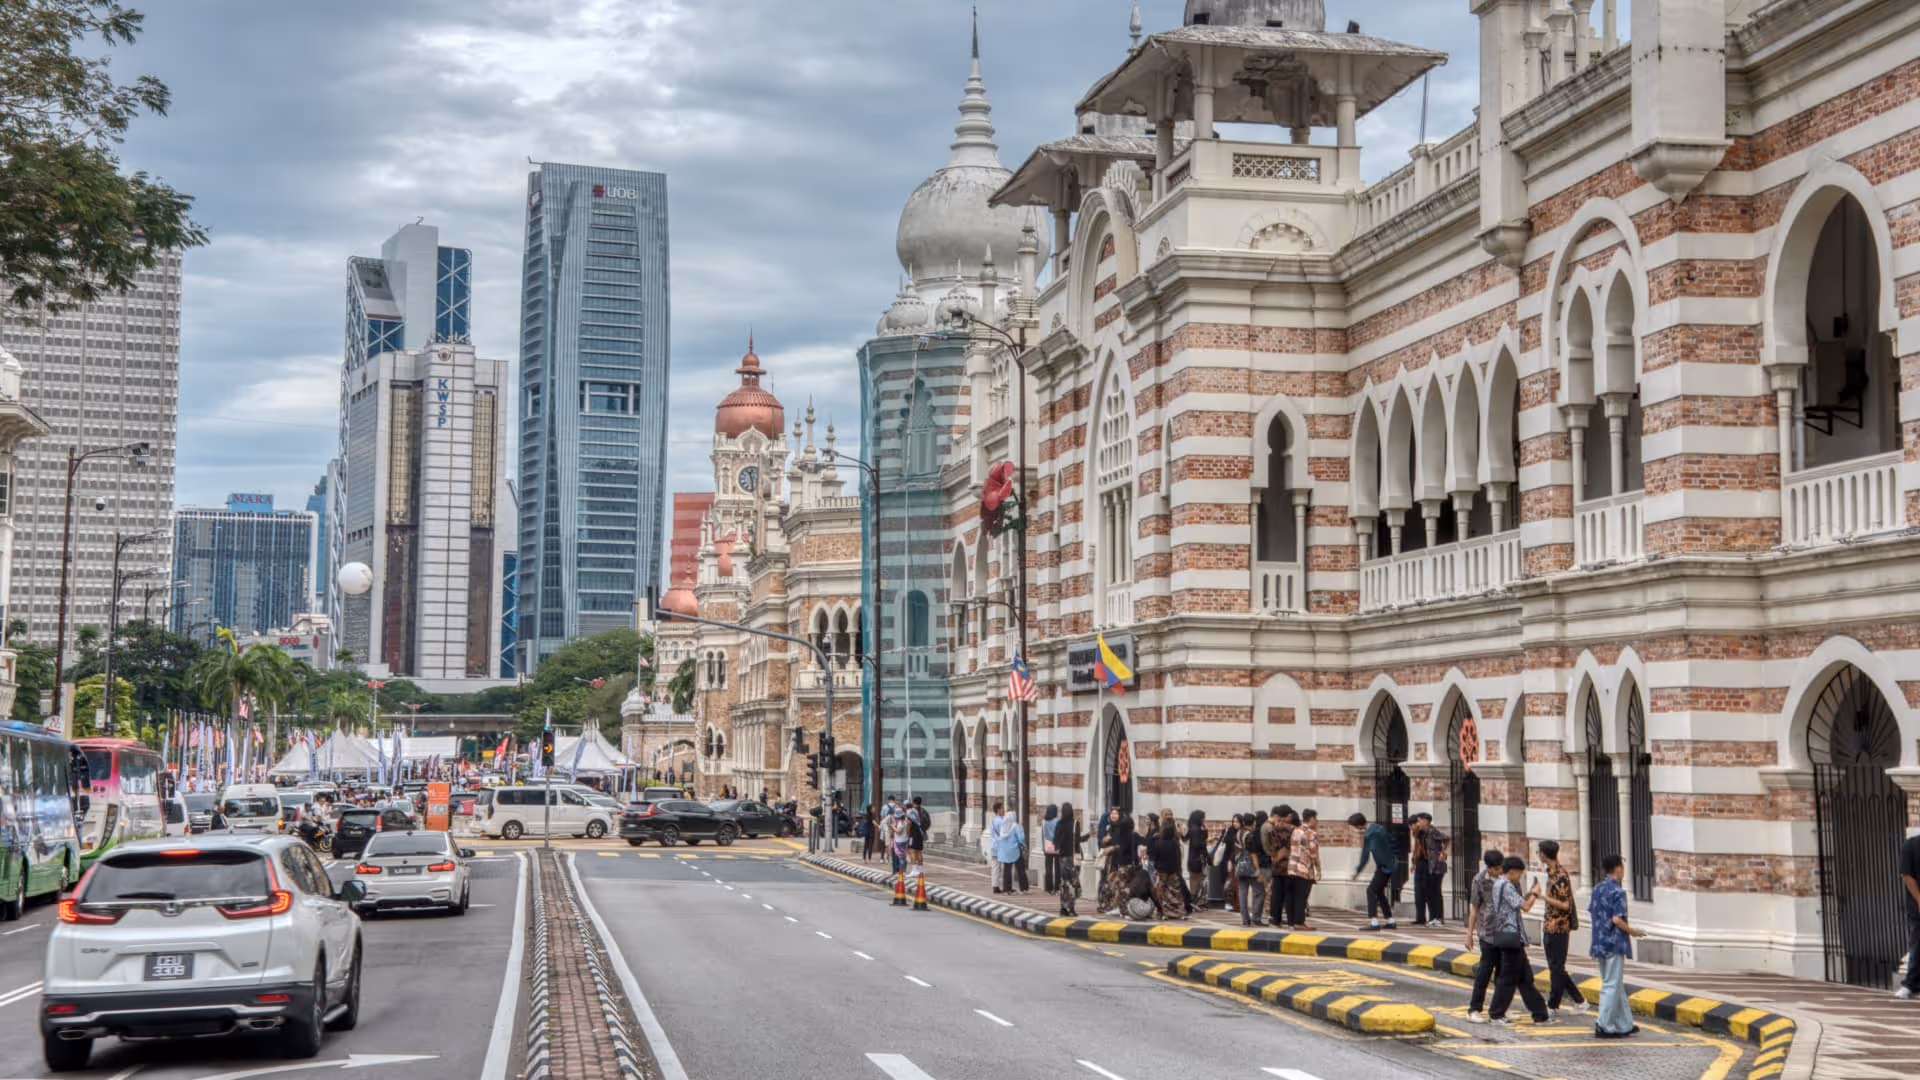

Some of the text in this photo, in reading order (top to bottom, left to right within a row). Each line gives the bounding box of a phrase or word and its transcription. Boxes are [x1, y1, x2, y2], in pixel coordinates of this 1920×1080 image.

[607, 186, 637, 200] UOB
[437, 379, 449, 427] KWSP
[233, 494, 272, 504] MARA
